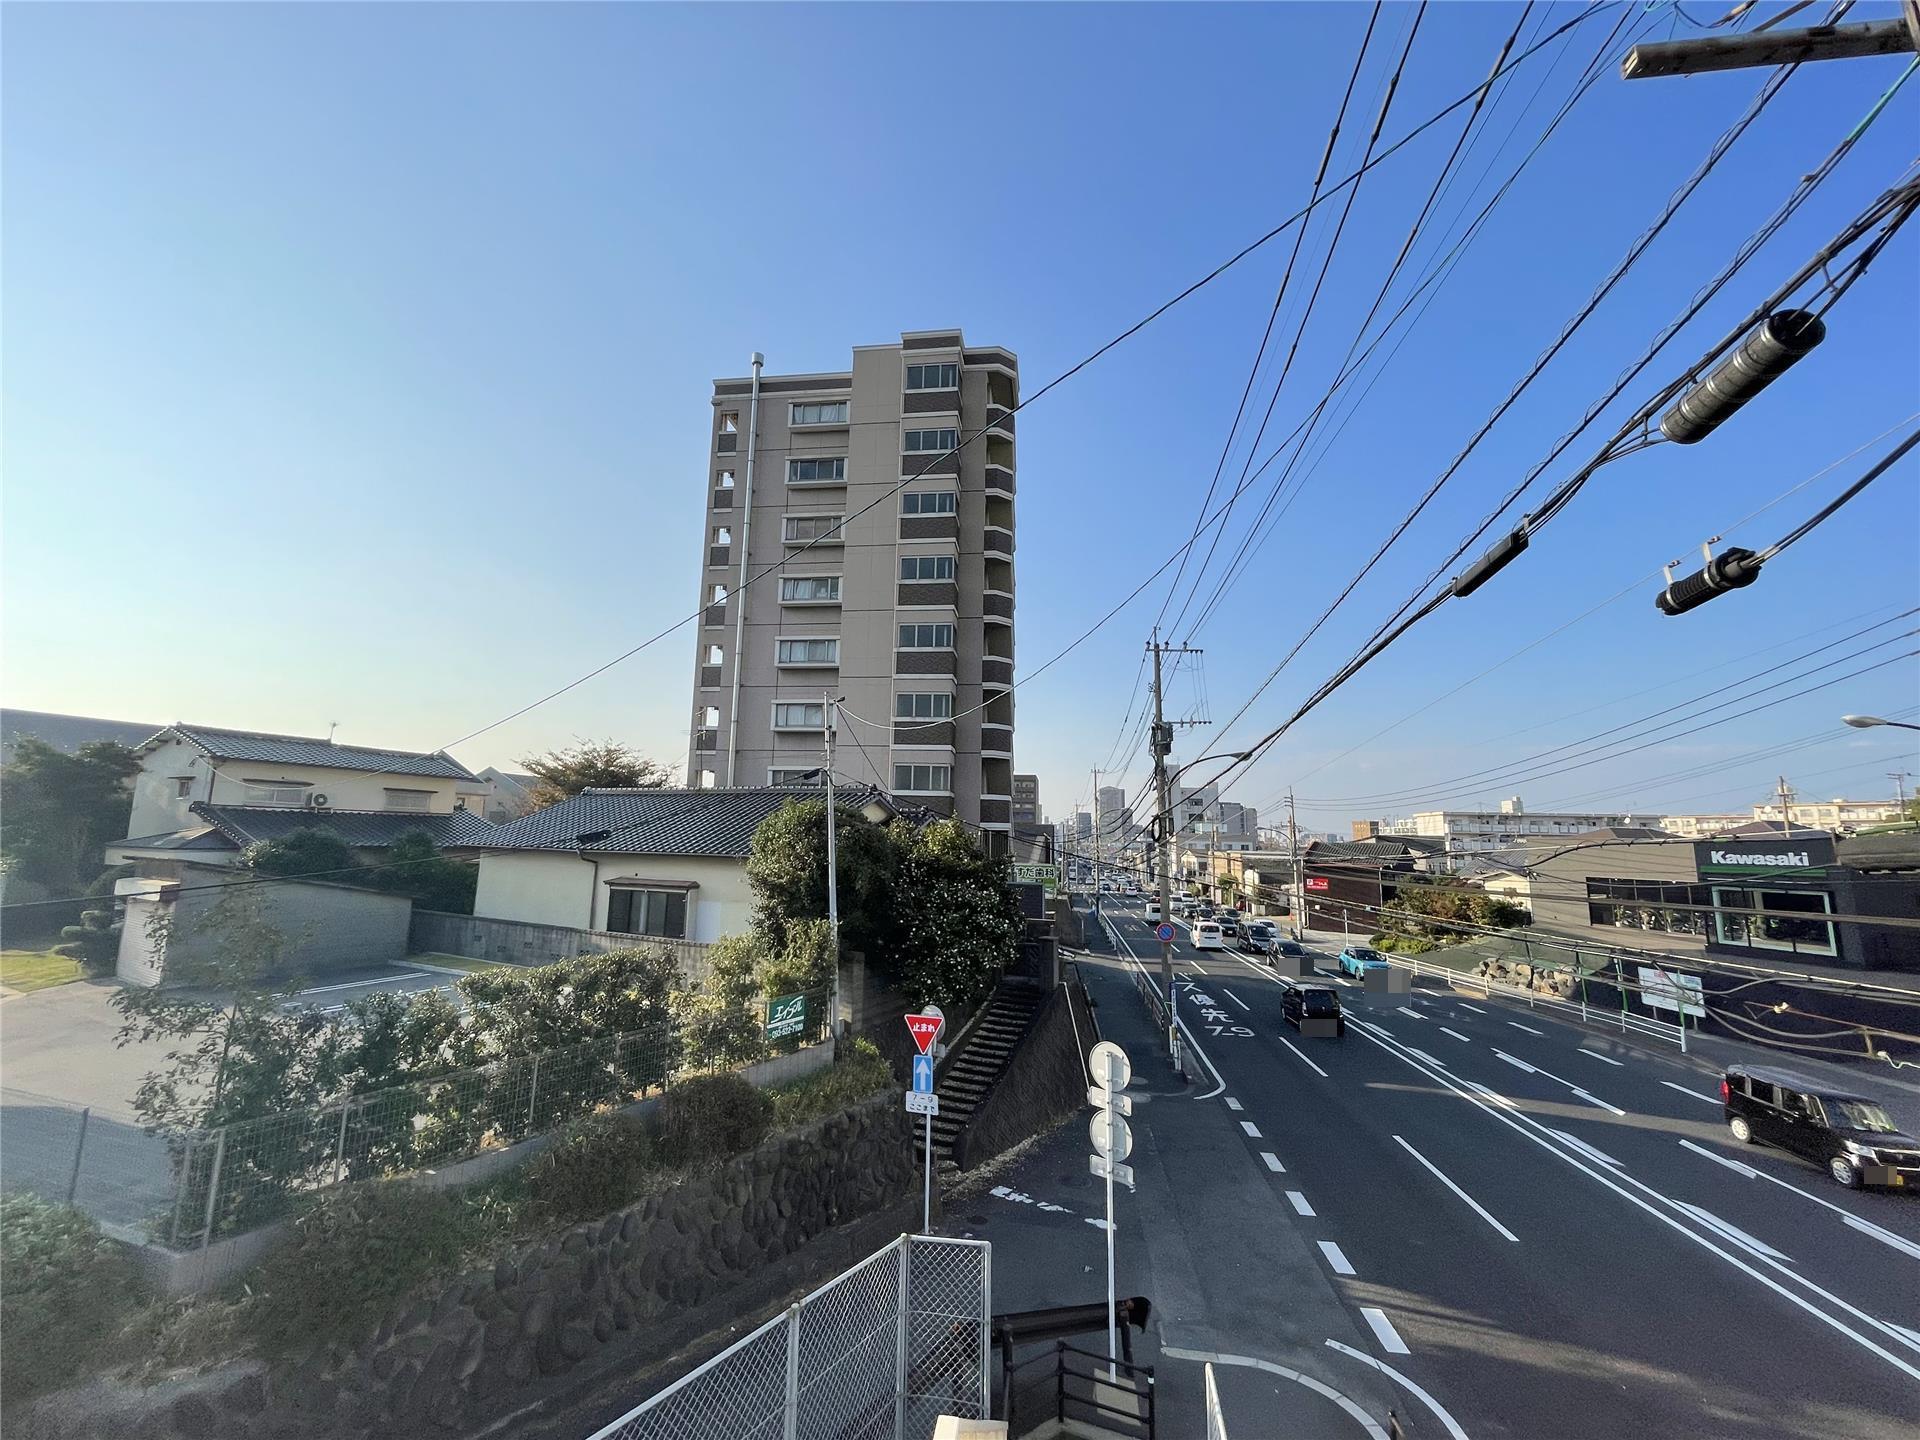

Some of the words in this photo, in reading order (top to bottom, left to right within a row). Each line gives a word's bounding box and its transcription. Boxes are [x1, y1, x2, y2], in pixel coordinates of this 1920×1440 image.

[1710, 850, 1810, 866] Kawasaki
[912, 1022, 936, 1033] 止まれ
[909, 1103, 936, 1113] ここまで
